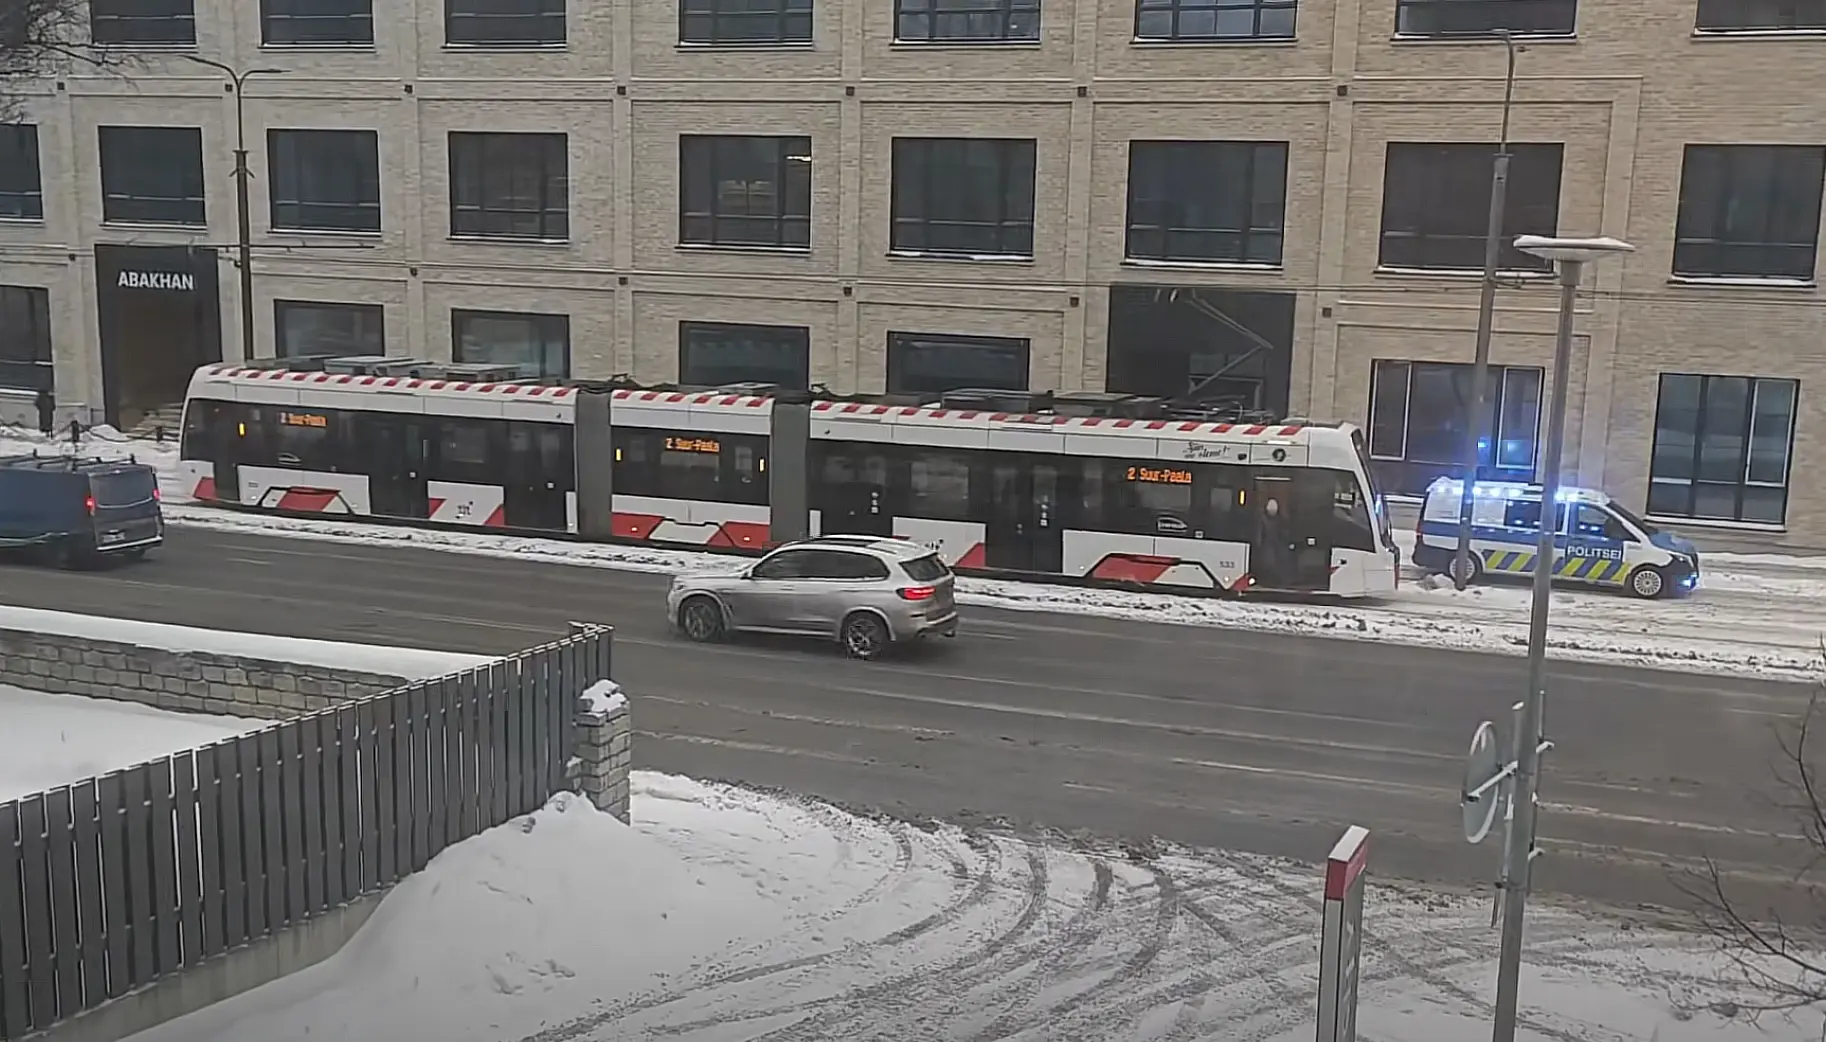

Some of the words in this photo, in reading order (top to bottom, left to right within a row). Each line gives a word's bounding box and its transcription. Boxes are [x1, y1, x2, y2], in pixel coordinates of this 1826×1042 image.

[118, 271, 194, 291] ABAKHAN
[1127, 466, 1137, 480] 2
[1567, 545, 1622, 560] POLITSEI
